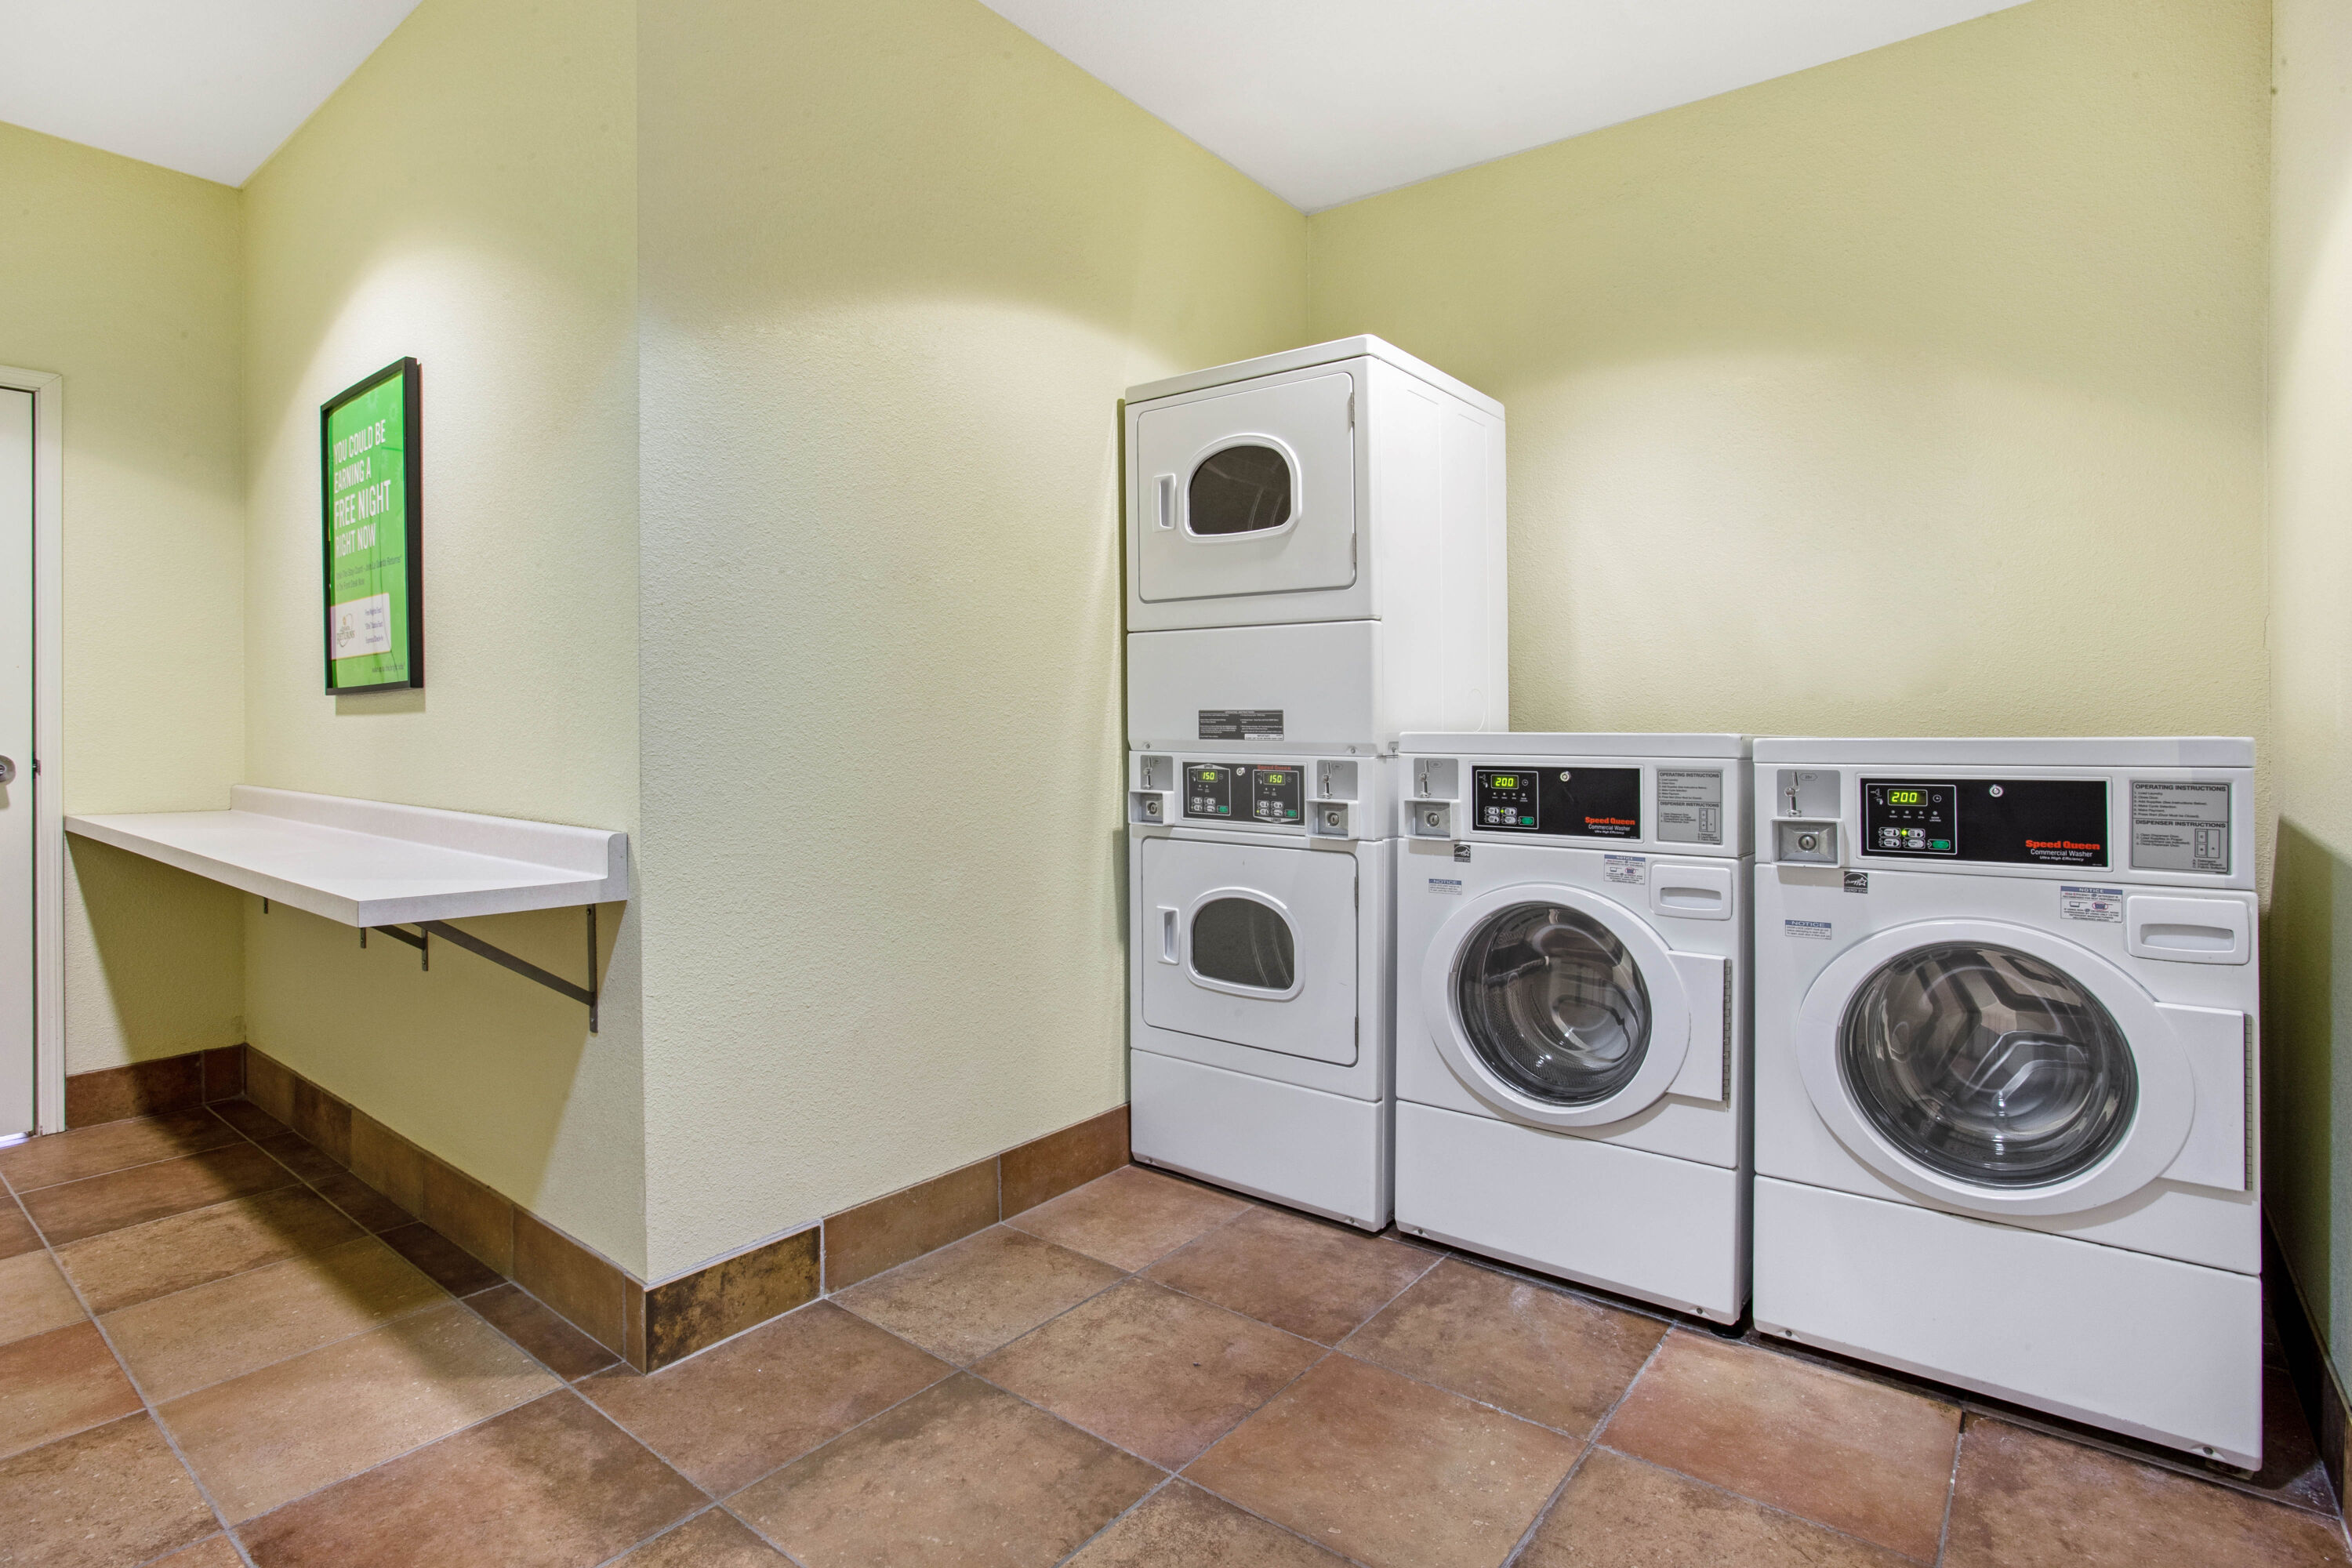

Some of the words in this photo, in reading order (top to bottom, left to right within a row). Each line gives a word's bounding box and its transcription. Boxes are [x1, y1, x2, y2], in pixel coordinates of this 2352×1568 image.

[333, 439, 347, 464] YOU
[349, 426, 373, 459] COULD
[375, 419, 386, 446] BE
[334, 459, 364, 494] EARNING
[366, 457, 371, 479] A
[334, 494, 356, 529] FREE
[358, 479, 390, 521] NIGHT
[336, 529, 356, 558] RIGHT
[358, 523, 376, 551] NOW
[1203, 771, 1215, 780] 150
[1269, 775, 1283, 783] 150
[1495, 778, 1514, 786] 200
[1892, 792, 1918, 803] 200
[2025, 840, 2061, 848] Speed
[2063, 840, 2100, 850] Queen
